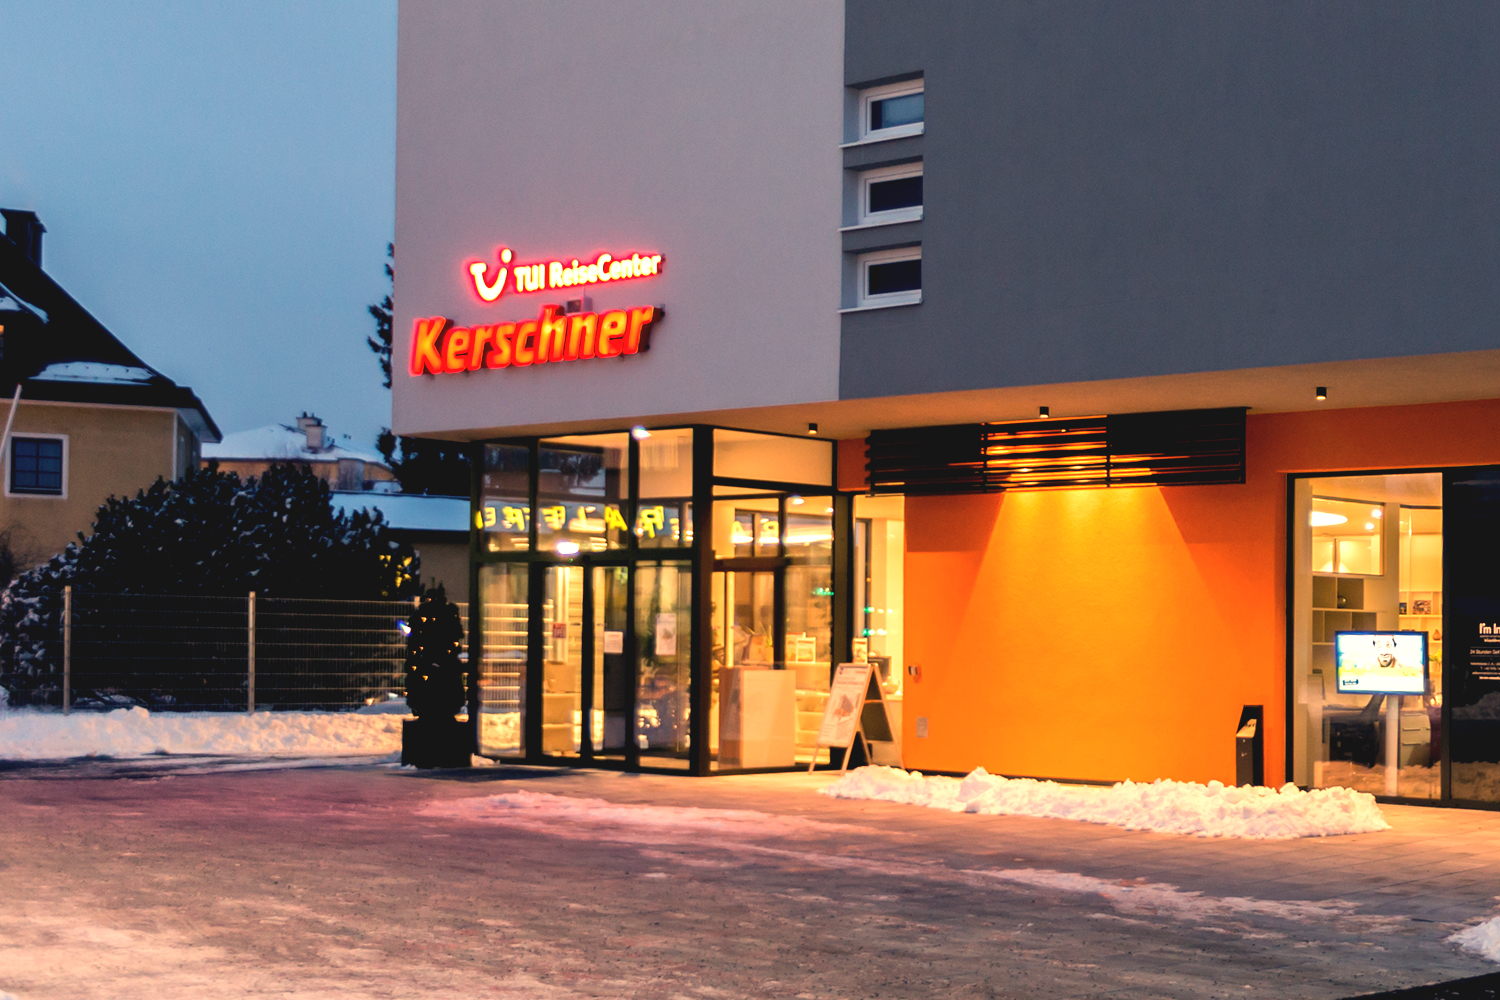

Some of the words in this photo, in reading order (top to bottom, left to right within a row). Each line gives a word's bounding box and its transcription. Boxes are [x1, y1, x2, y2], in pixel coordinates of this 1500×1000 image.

[513, 263, 545, 292] TUI
[549, 252, 662, 288] ReiseCenter
[409, 304, 656, 376] Kerschner
[1479, 623, 1492, 634] I'm
